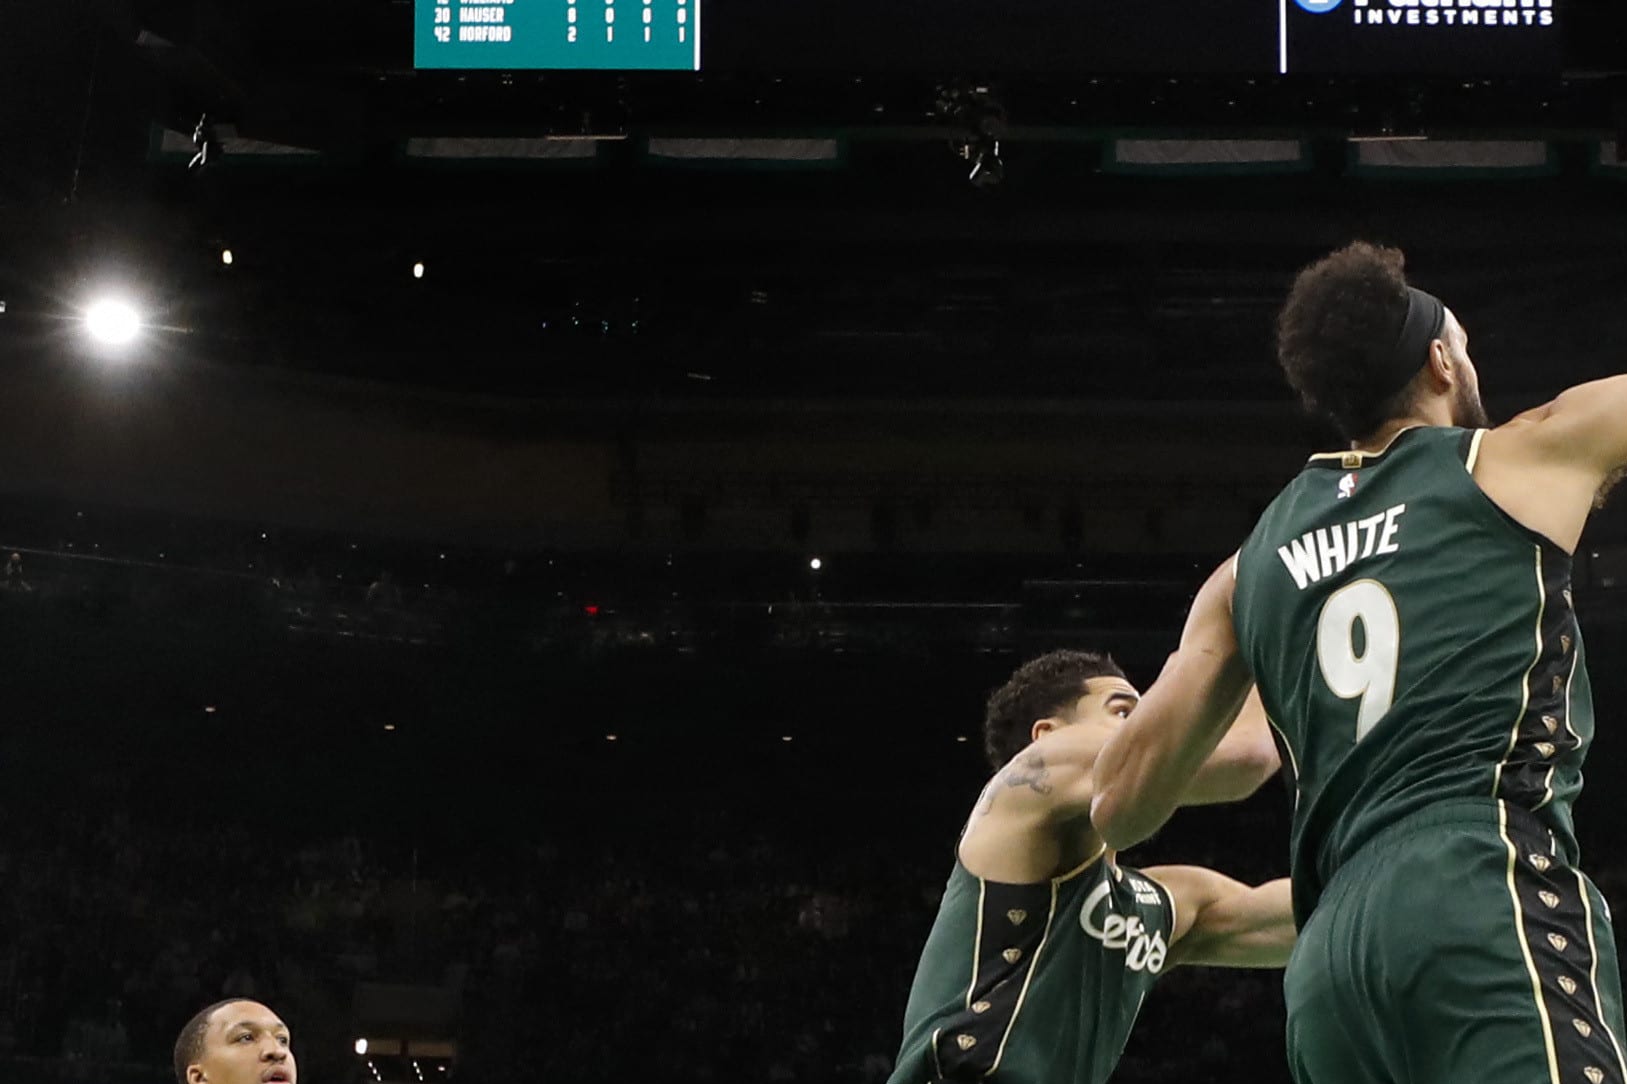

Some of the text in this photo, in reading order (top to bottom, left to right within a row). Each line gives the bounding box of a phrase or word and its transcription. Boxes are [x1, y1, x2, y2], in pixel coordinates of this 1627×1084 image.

[434, 7, 450, 23] 30
[459, 7, 504, 23] HAUSER
[1354, 9, 1553, 25] INVESTMENTS
[434, 26, 685, 43] 42 HORFORD 2 1 1 1
[1277, 504, 1406, 590] WHITE
[1317, 578, 1399, 744] 9
